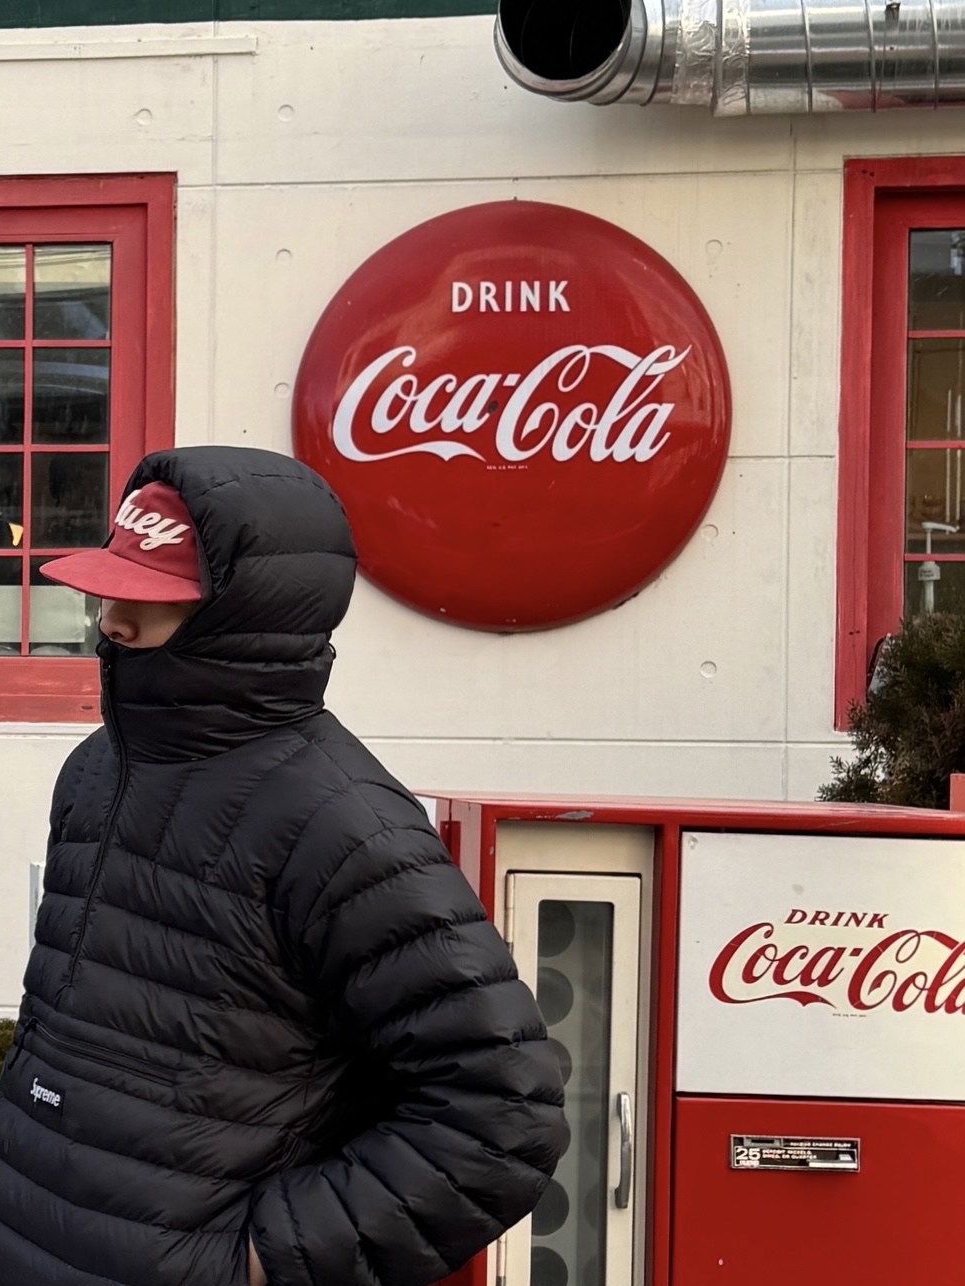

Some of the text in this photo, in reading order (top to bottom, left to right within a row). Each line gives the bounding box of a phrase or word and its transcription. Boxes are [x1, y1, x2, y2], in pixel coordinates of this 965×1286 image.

[451, 280, 571, 312] DRINK
[333, 344, 692, 462] Coca-Cola
[784, 908, 889, 929] DRINK
[736, 1148, 760, 1160] 25
